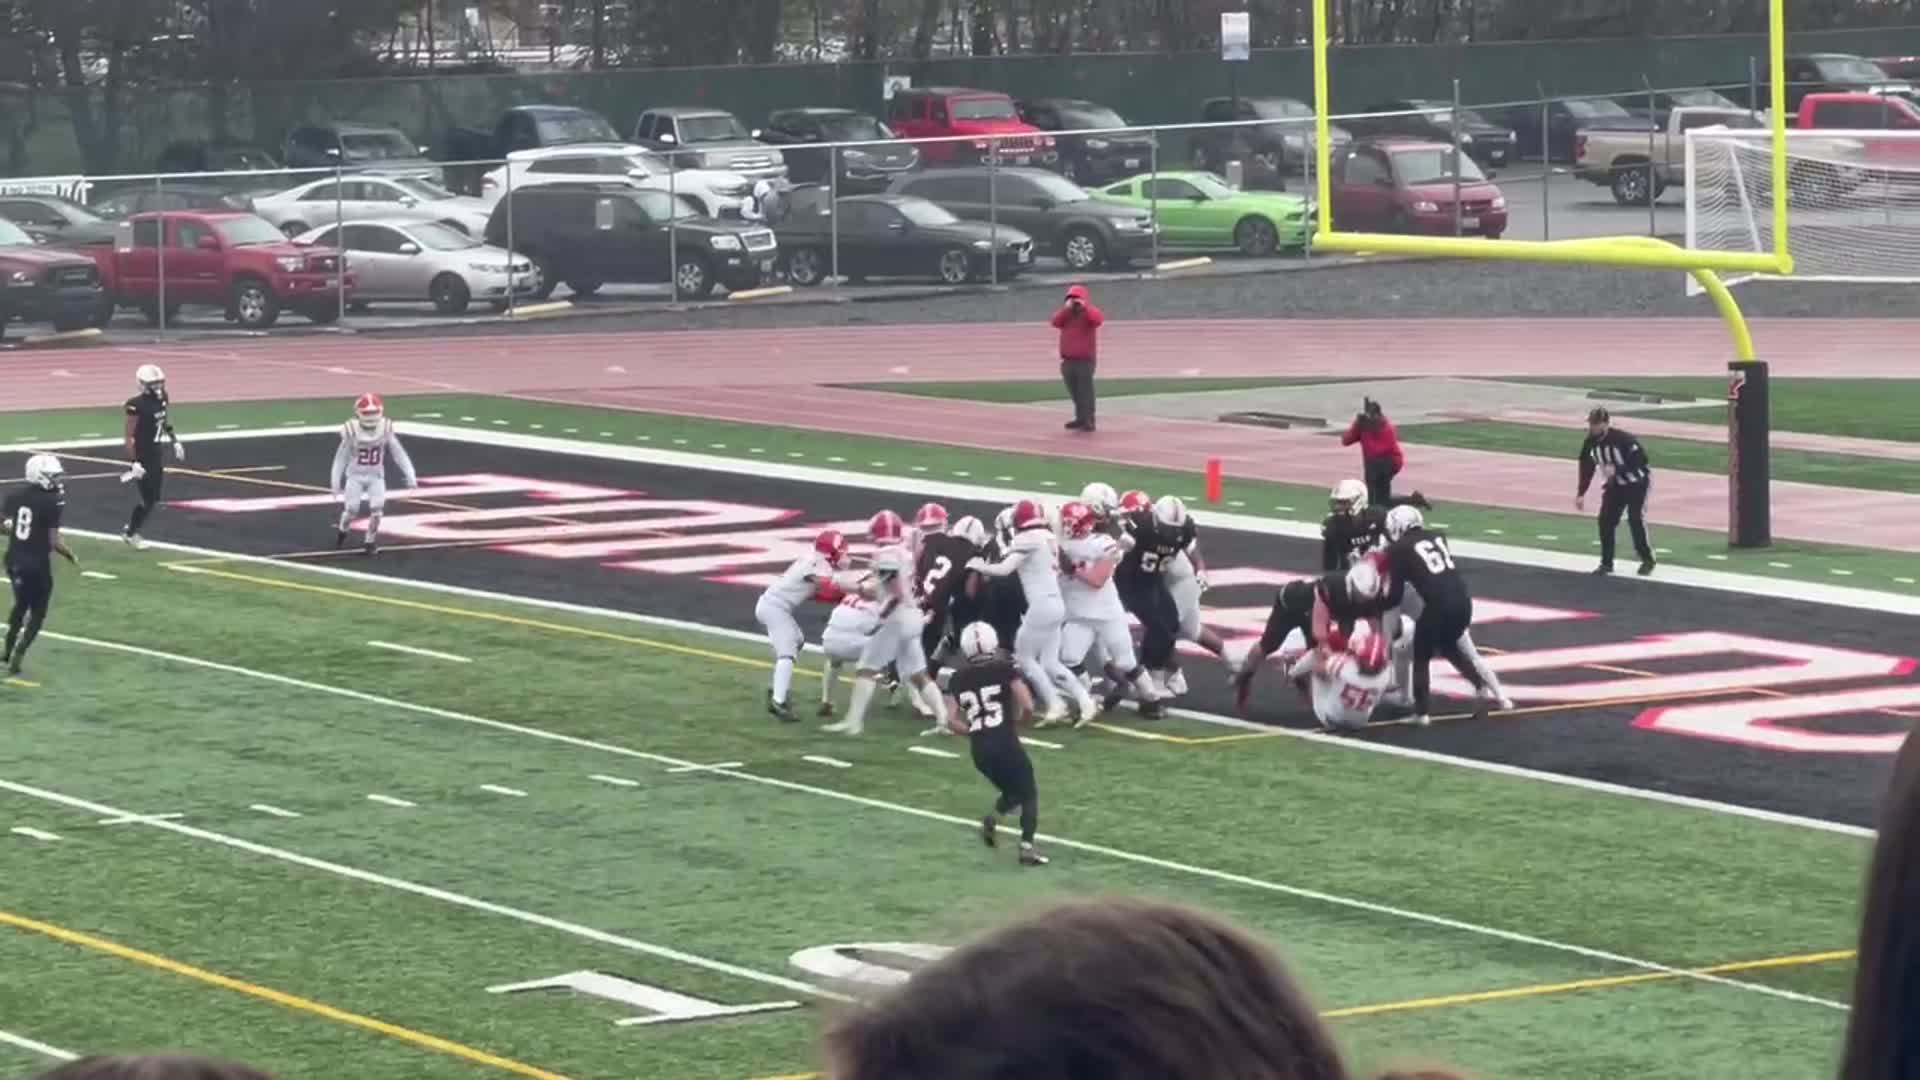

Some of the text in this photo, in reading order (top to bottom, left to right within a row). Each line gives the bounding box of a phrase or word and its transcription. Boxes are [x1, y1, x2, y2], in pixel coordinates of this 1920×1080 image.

[348, 446, 382, 466] 20
[15, 506, 33, 541] 8
[1414, 536, 1455, 574] 61
[923, 555, 953, 595] 2
[959, 684, 1003, 732] 25
